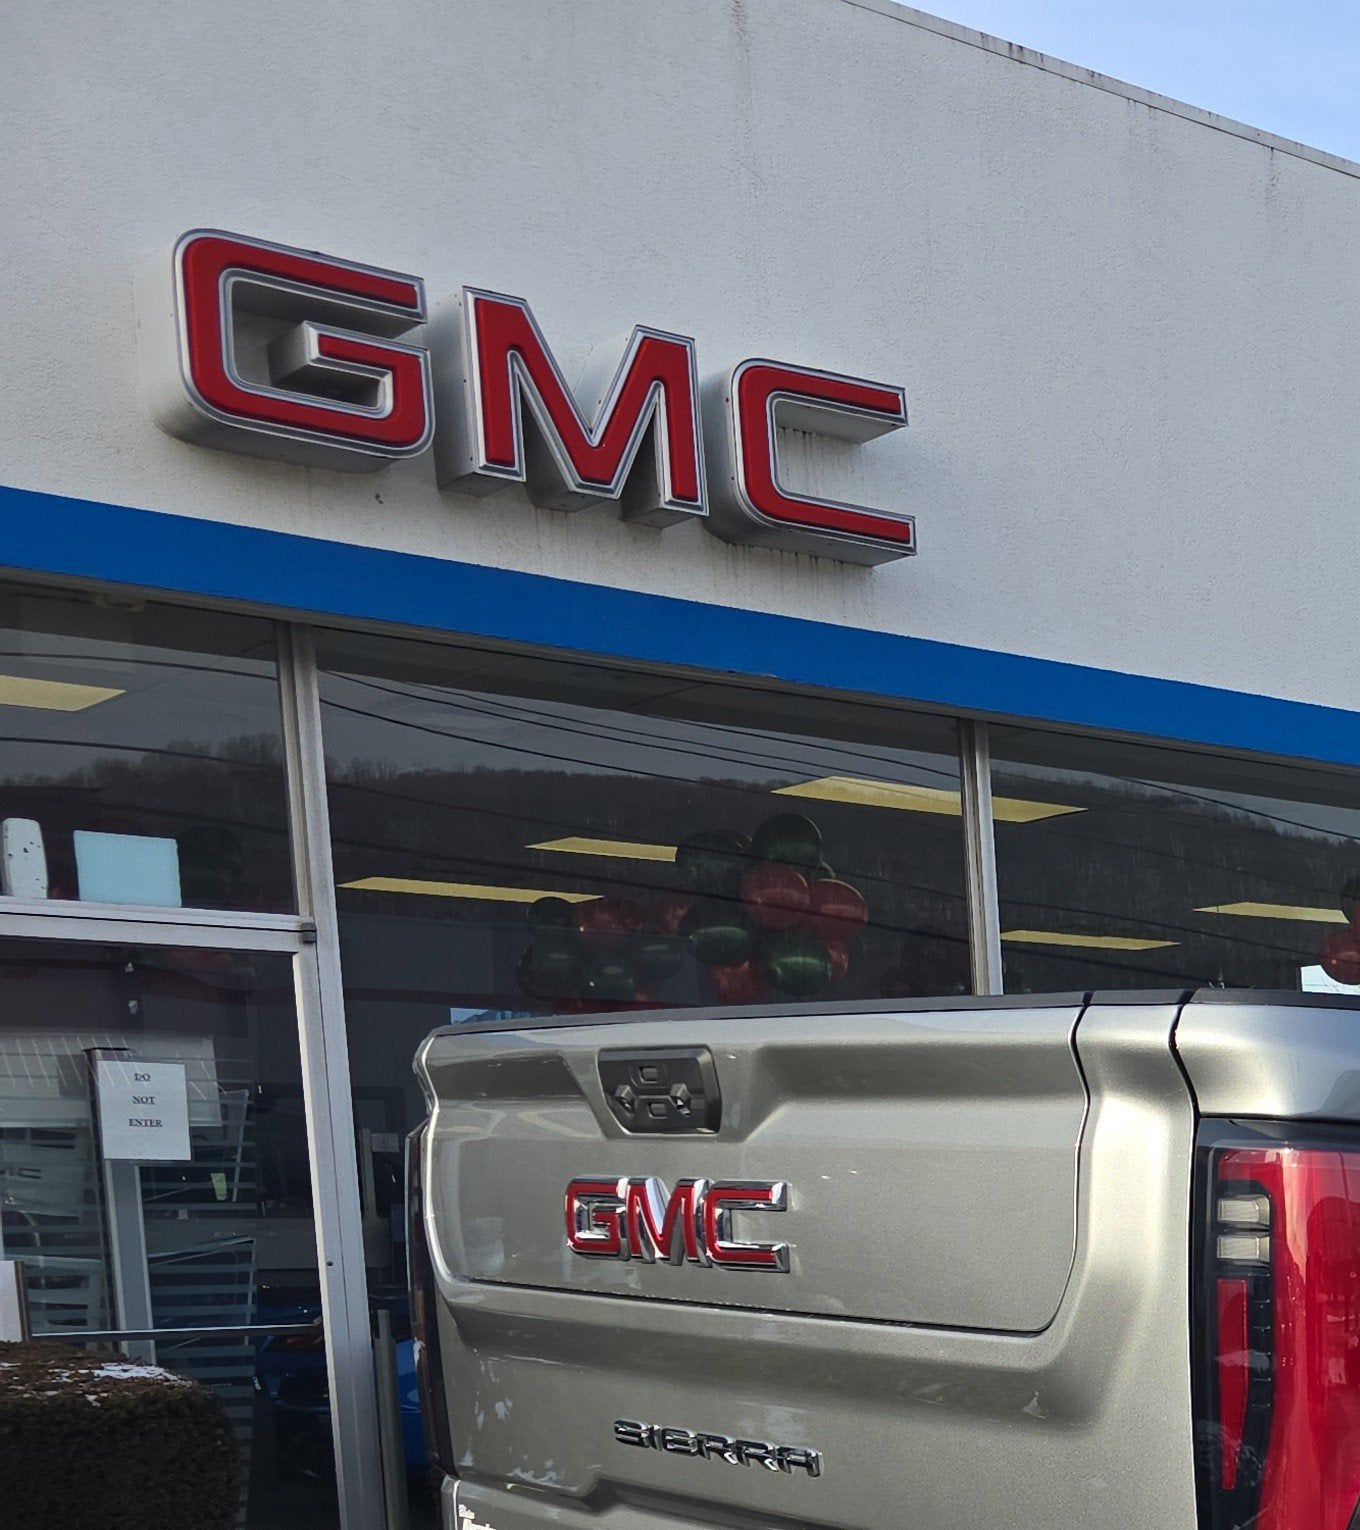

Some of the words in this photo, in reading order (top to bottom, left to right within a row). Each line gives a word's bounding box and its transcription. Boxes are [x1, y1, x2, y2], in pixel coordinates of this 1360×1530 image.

[173, 228, 916, 558] GMC
[134, 1073, 151, 1082] DO
[132, 1095, 156, 1105] NOT
[128, 1118, 163, 1128] ENTER
[564, 1175, 790, 1273] GMC
[613, 1419, 820, 1477] SIERRA
